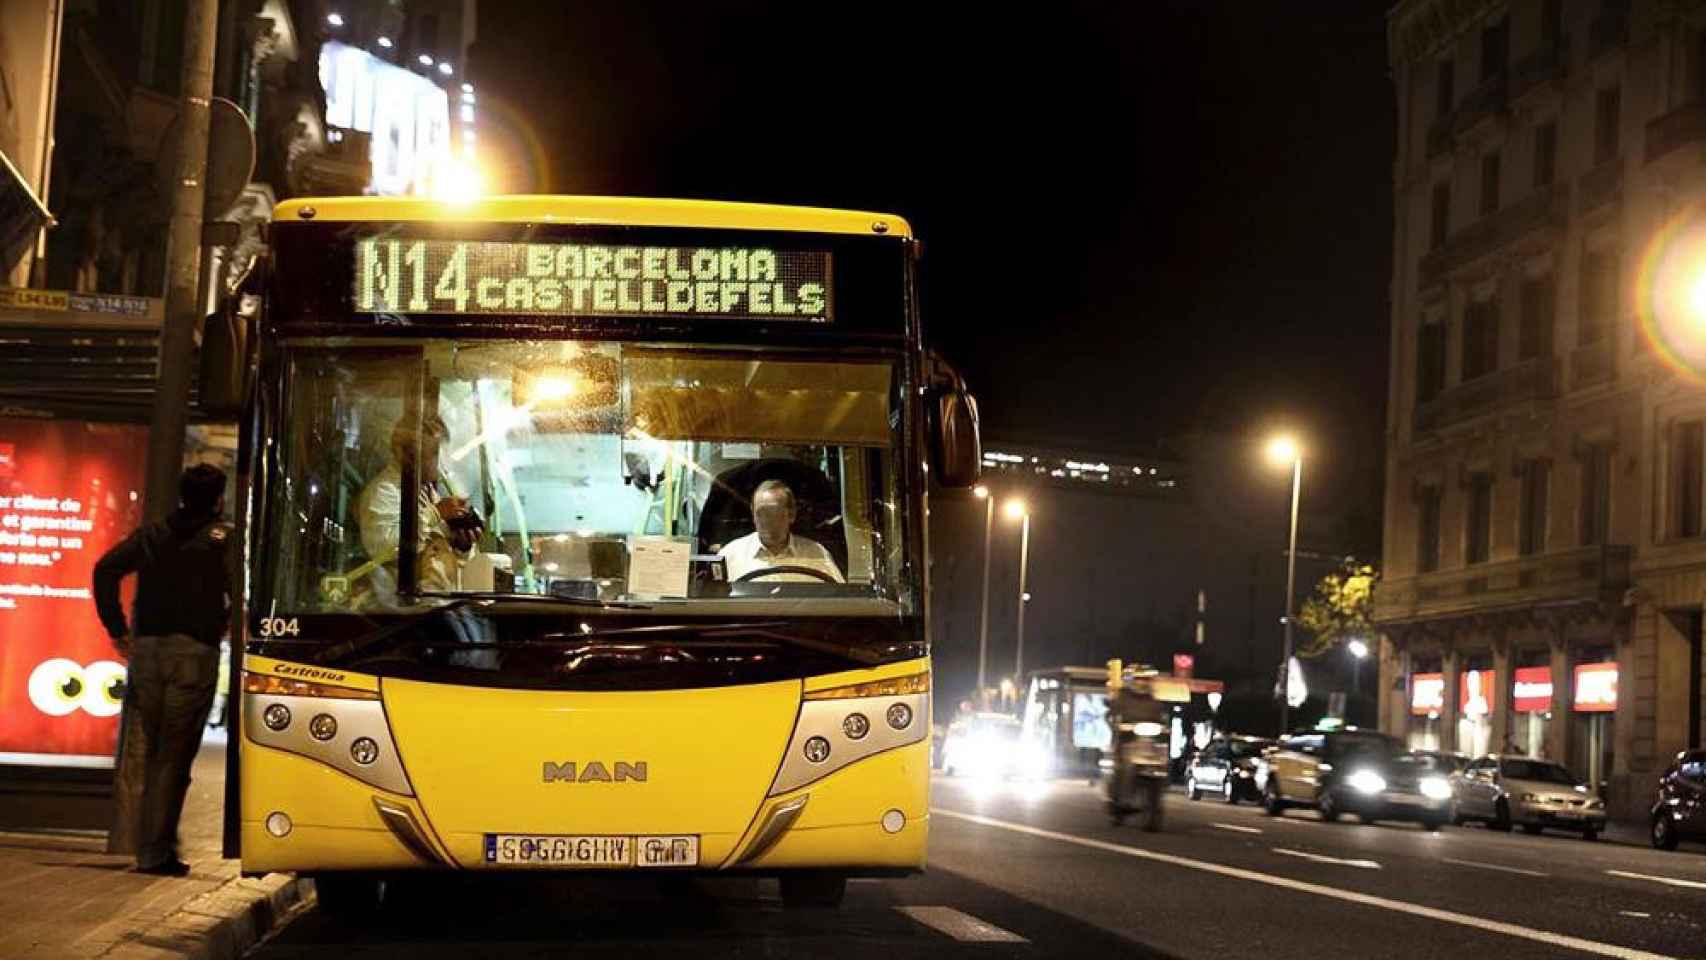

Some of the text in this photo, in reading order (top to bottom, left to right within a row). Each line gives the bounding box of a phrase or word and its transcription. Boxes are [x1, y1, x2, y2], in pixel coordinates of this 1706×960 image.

[359, 238, 470, 313] N14
[475, 276, 826, 314] CASTELLDEFELS
[260, 616, 300, 637] 304
[542, 761, 648, 783] MAN
